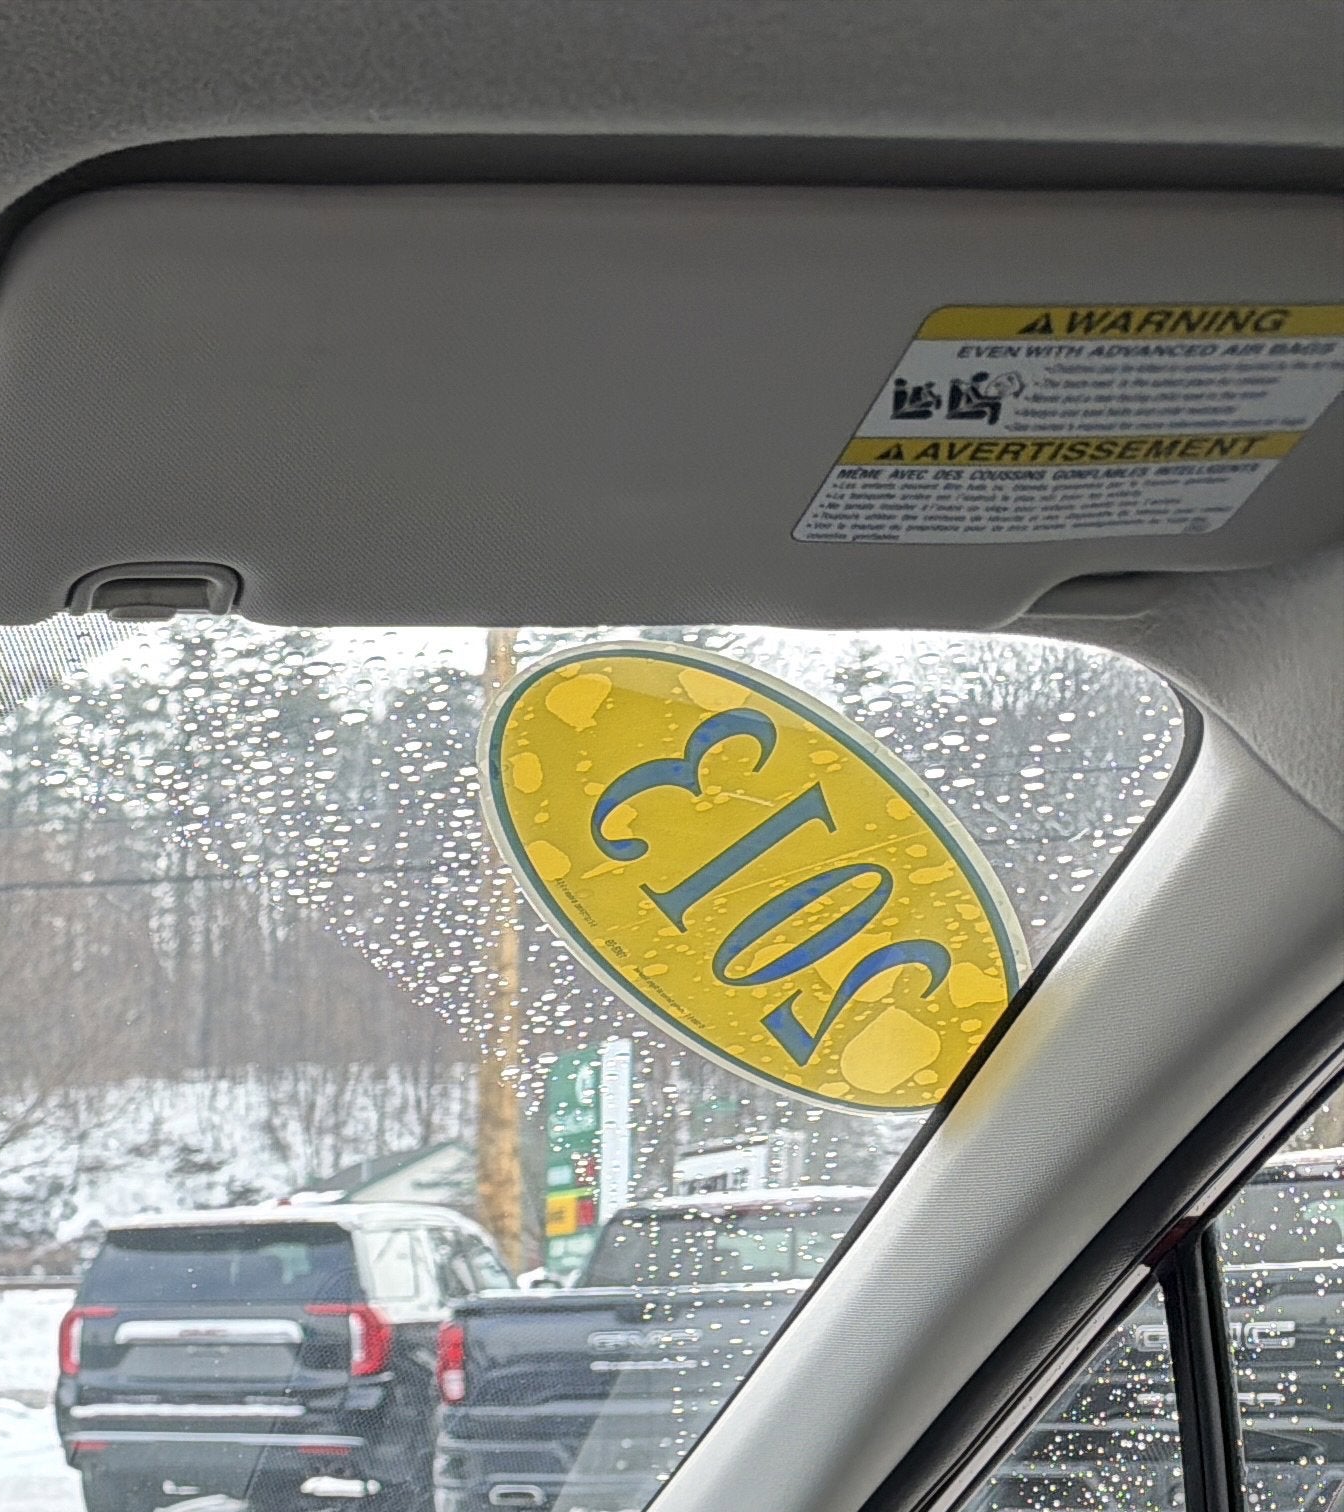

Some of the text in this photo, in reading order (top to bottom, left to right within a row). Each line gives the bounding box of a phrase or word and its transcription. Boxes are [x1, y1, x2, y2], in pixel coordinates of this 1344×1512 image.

[1064, 308, 1291, 336] WARNING
[957, 344, 1022, 359] EVEN
[1025, 344, 1084, 358] WITH
[1090, 343, 1217, 358] ADVANCED
[1223, 343, 1266, 356] AIR
[917, 436, 1269, 463] AVERTISSEMENT
[888, 468, 930, 480] AVEC
[932, 469, 965, 480] DES
